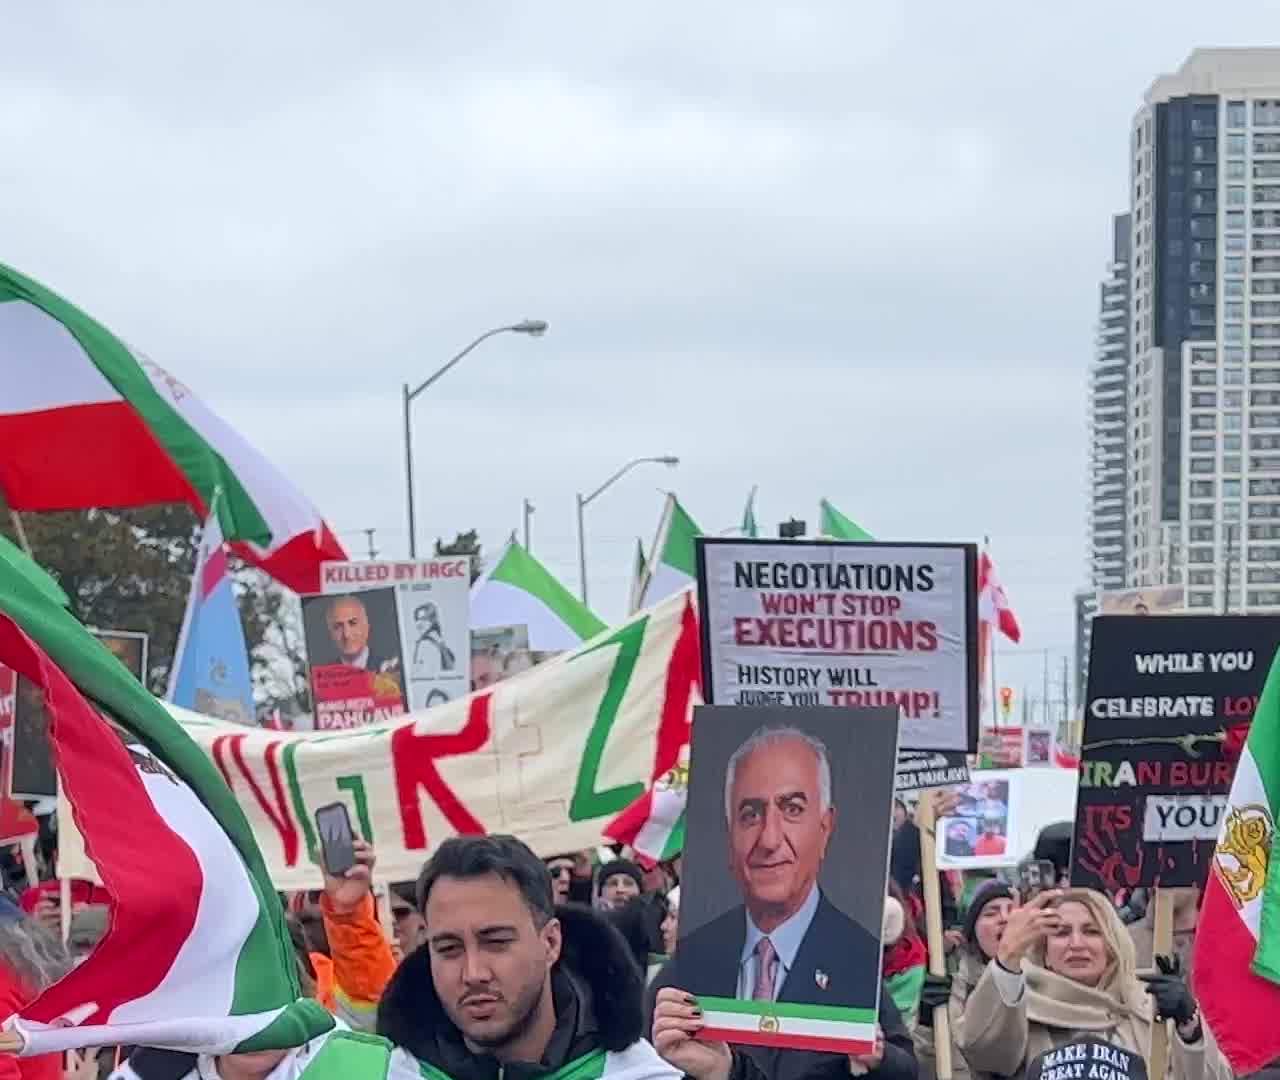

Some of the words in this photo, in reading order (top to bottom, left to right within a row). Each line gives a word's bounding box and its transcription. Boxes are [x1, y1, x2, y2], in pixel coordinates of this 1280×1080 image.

[325, 564, 389, 583] KILLED
[394, 563, 417, 580] BY
[423, 560, 465, 577] IRGC
[734, 561, 934, 592] NEGOTIATIONS
[761, 592, 836, 616] WON'T
[842, 594, 901, 616] STOP
[734, 617, 938, 650] EXECUTIONS
[738, 664, 821, 686] HISTORY
[827, 668, 878, 686] WILL
[1135, 653, 1205, 674] WHILE
[1209, 651, 1254, 672] YOU
[827, 690, 940, 718] TRUMP!
[1090, 696, 1214, 718] CELEBRATE
[1080, 760, 1161, 787] IRAN
[1043, 1044, 1087, 1070] MAKE
[1091, 1044, 1130, 1072] IRAN
